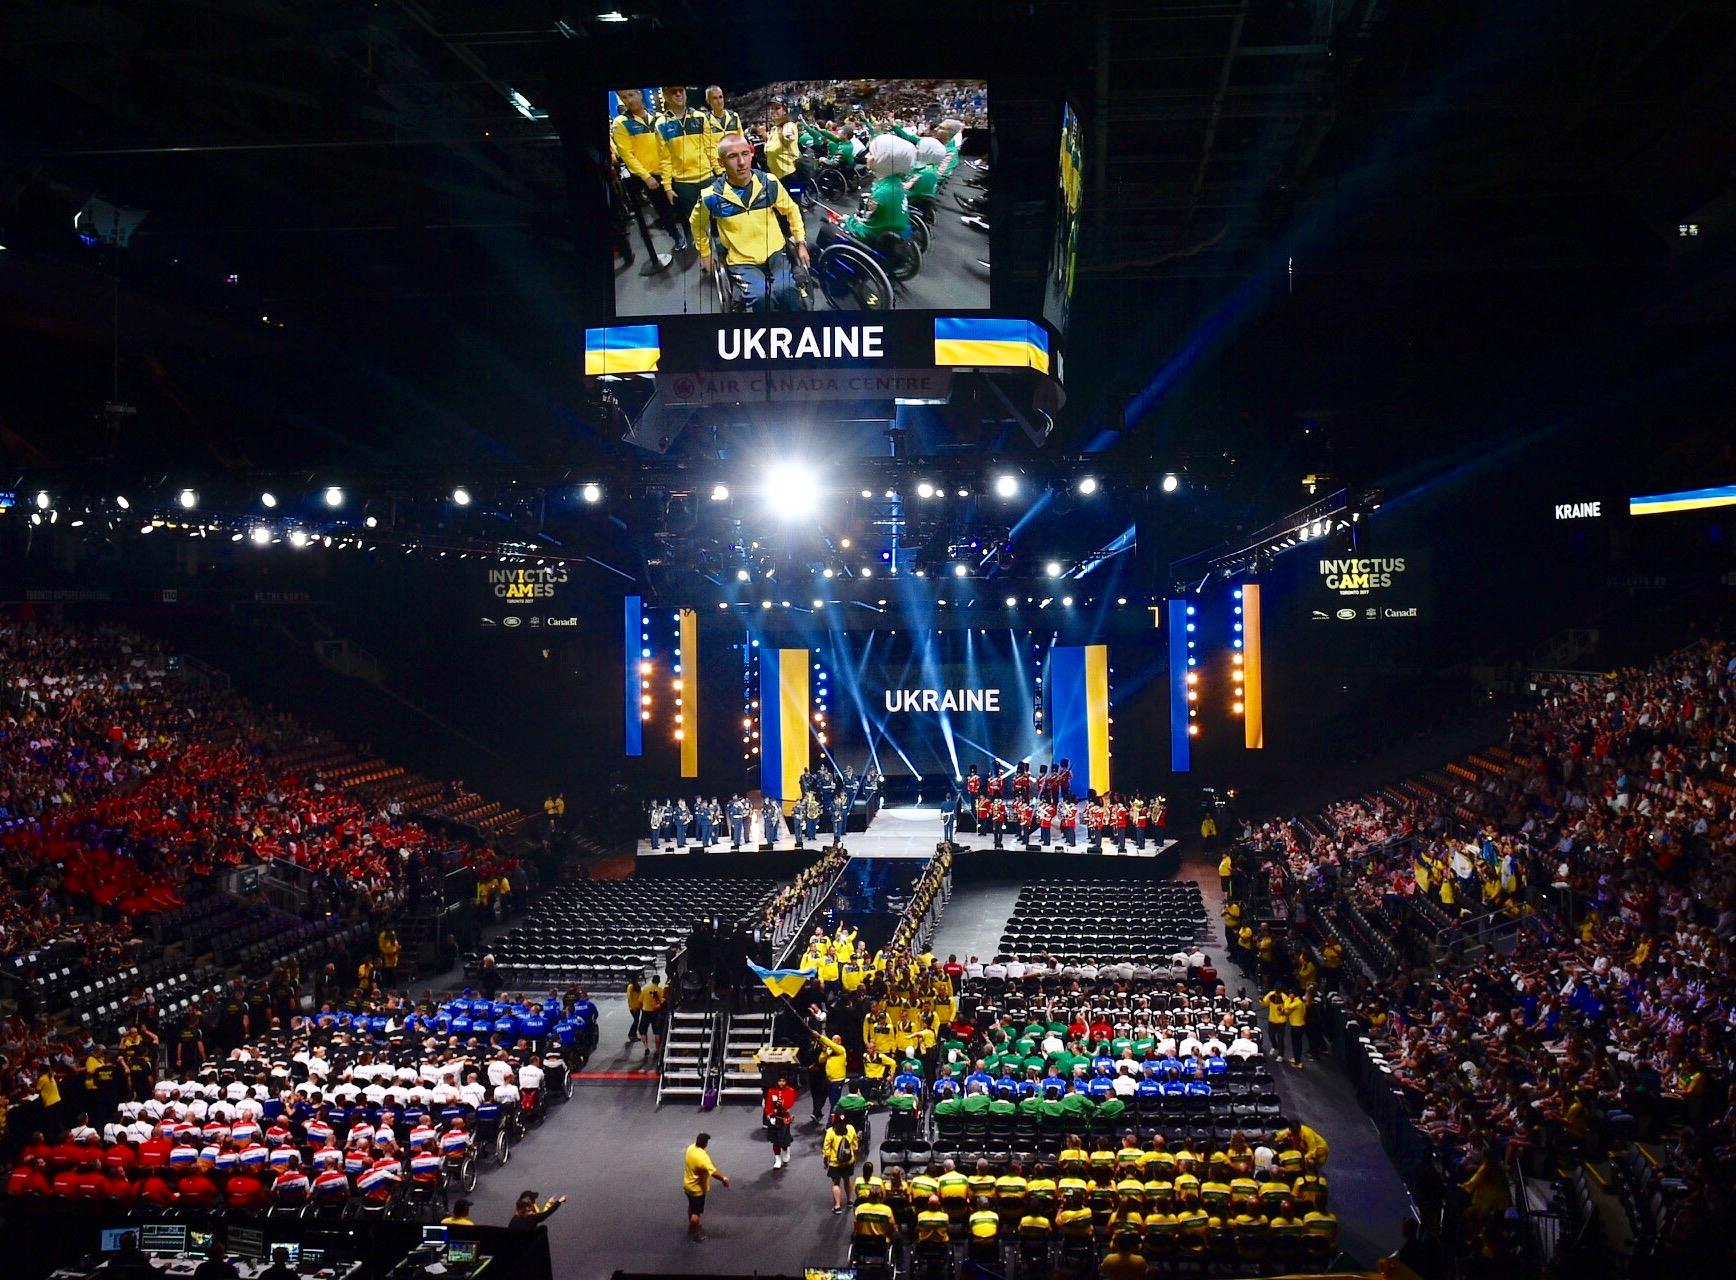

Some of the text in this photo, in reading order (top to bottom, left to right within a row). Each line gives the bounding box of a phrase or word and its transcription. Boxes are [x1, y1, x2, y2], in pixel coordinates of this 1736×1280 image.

[718, 326, 884, 360] UKRAINE
[706, 377, 931, 393] AIR CANADA CENTRE
[1320, 558, 1406, 574] INVICTUS
[1326, 573, 1392, 589] GAMES
[494, 584, 555, 598] GAMES
[1385, 608, 1418, 618] Canada
[547, 617, 578, 626] Canada
[885, 689, 1001, 712] UKRAINE
